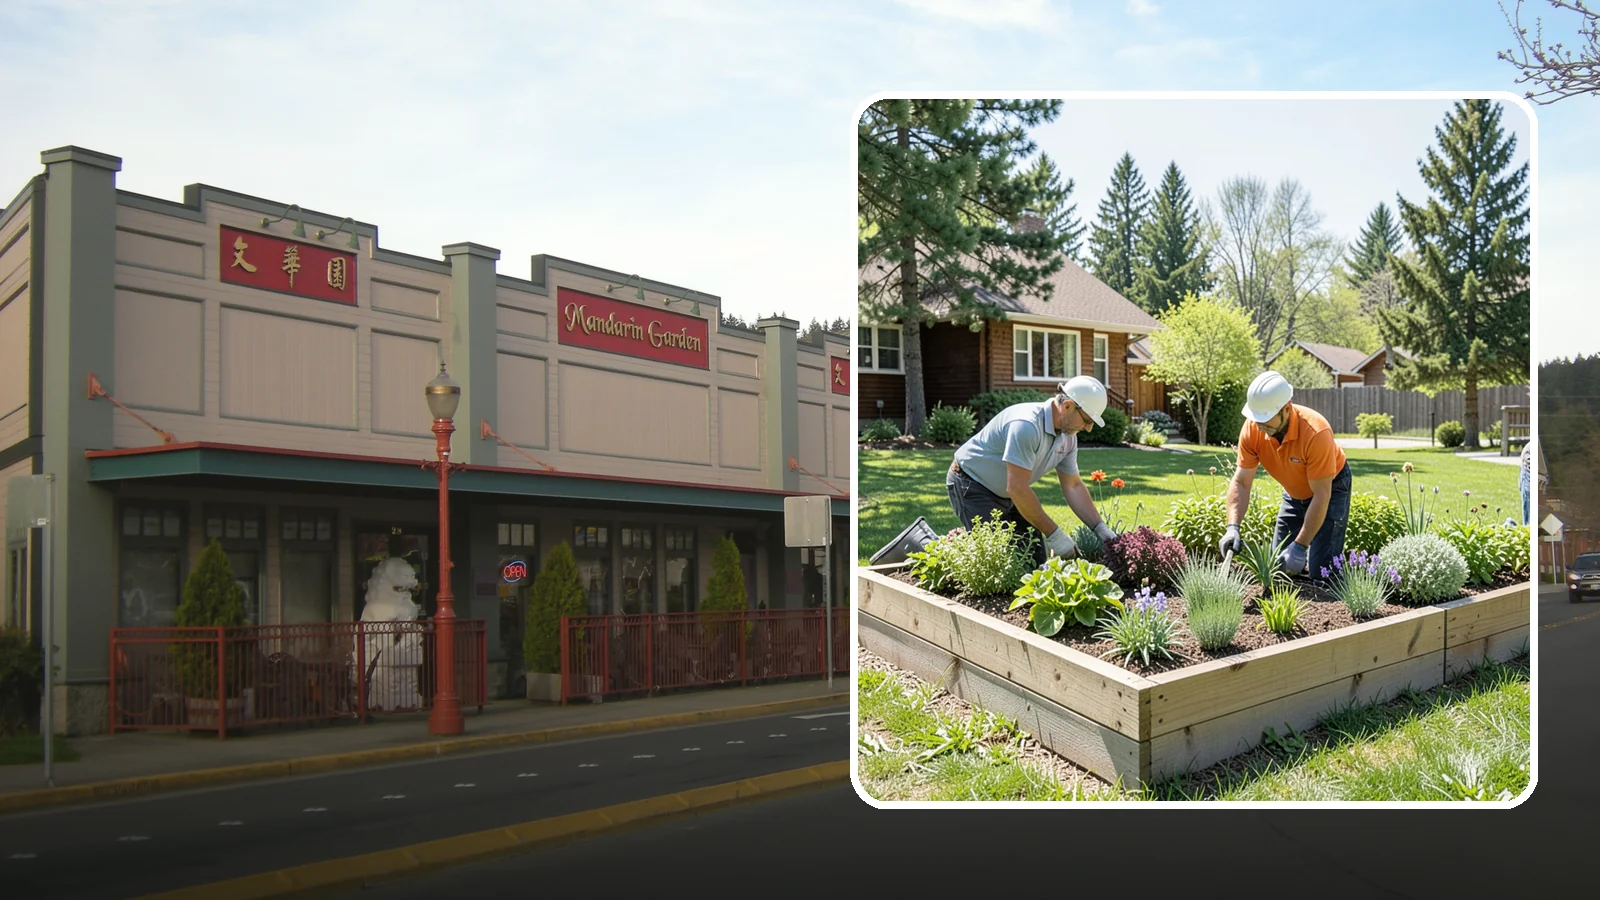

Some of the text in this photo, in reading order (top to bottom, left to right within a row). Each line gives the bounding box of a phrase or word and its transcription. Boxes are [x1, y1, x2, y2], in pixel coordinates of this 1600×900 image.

[231, 235, 346, 291] 文華園
[564, 302, 701, 352] Mandarin Garden
[503, 565, 527, 578] OPEN
